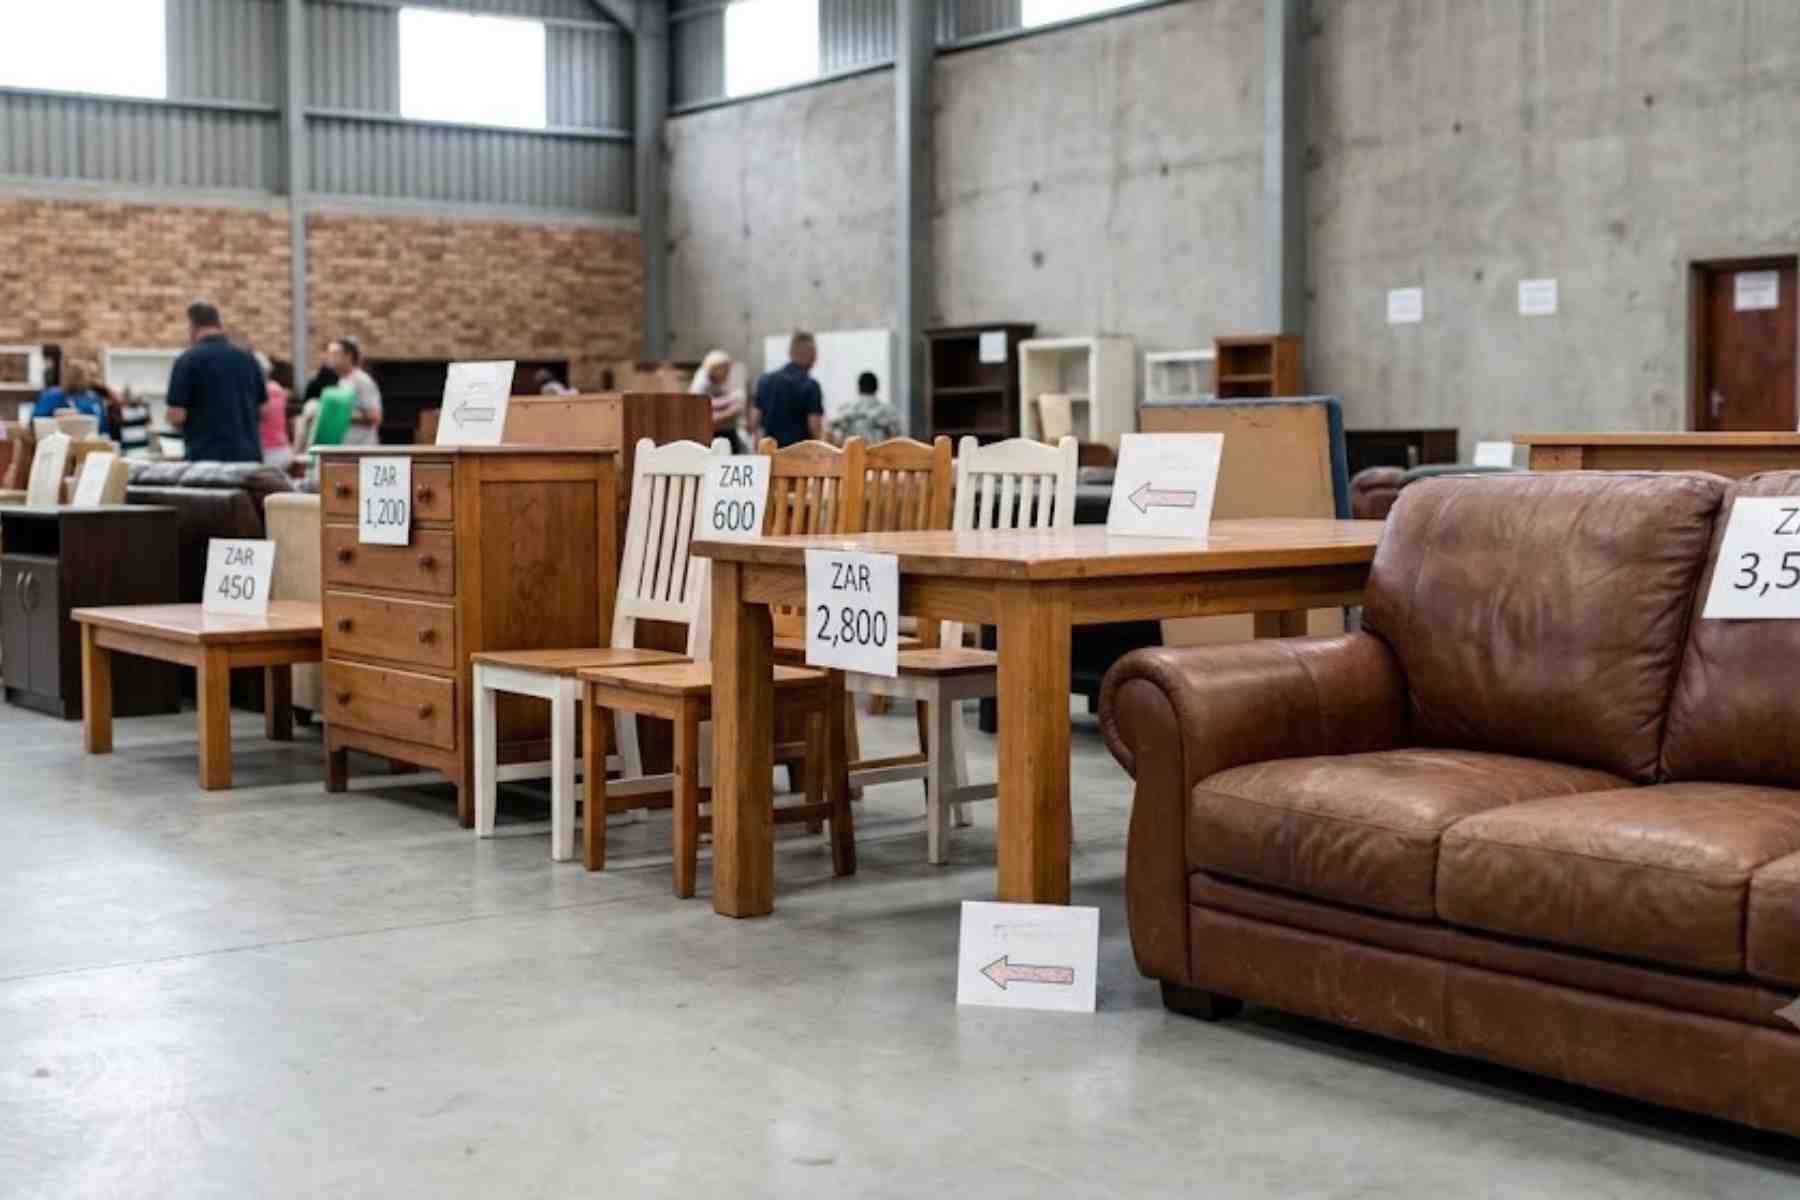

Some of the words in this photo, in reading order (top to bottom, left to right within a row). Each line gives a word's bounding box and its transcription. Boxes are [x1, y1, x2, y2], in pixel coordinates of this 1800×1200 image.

[373, 465, 397, 486] ZAR
[719, 464, 754, 489] ZAR
[365, 498, 406, 529] 1,200
[713, 499, 756, 531] 600
[1773, 507, 1800, 535] Z
[224, 546, 255, 566] ZAR
[217, 575, 256, 600] 450
[831, 562, 871, 592] ZAR
[817, 604, 887, 647] 2,800
